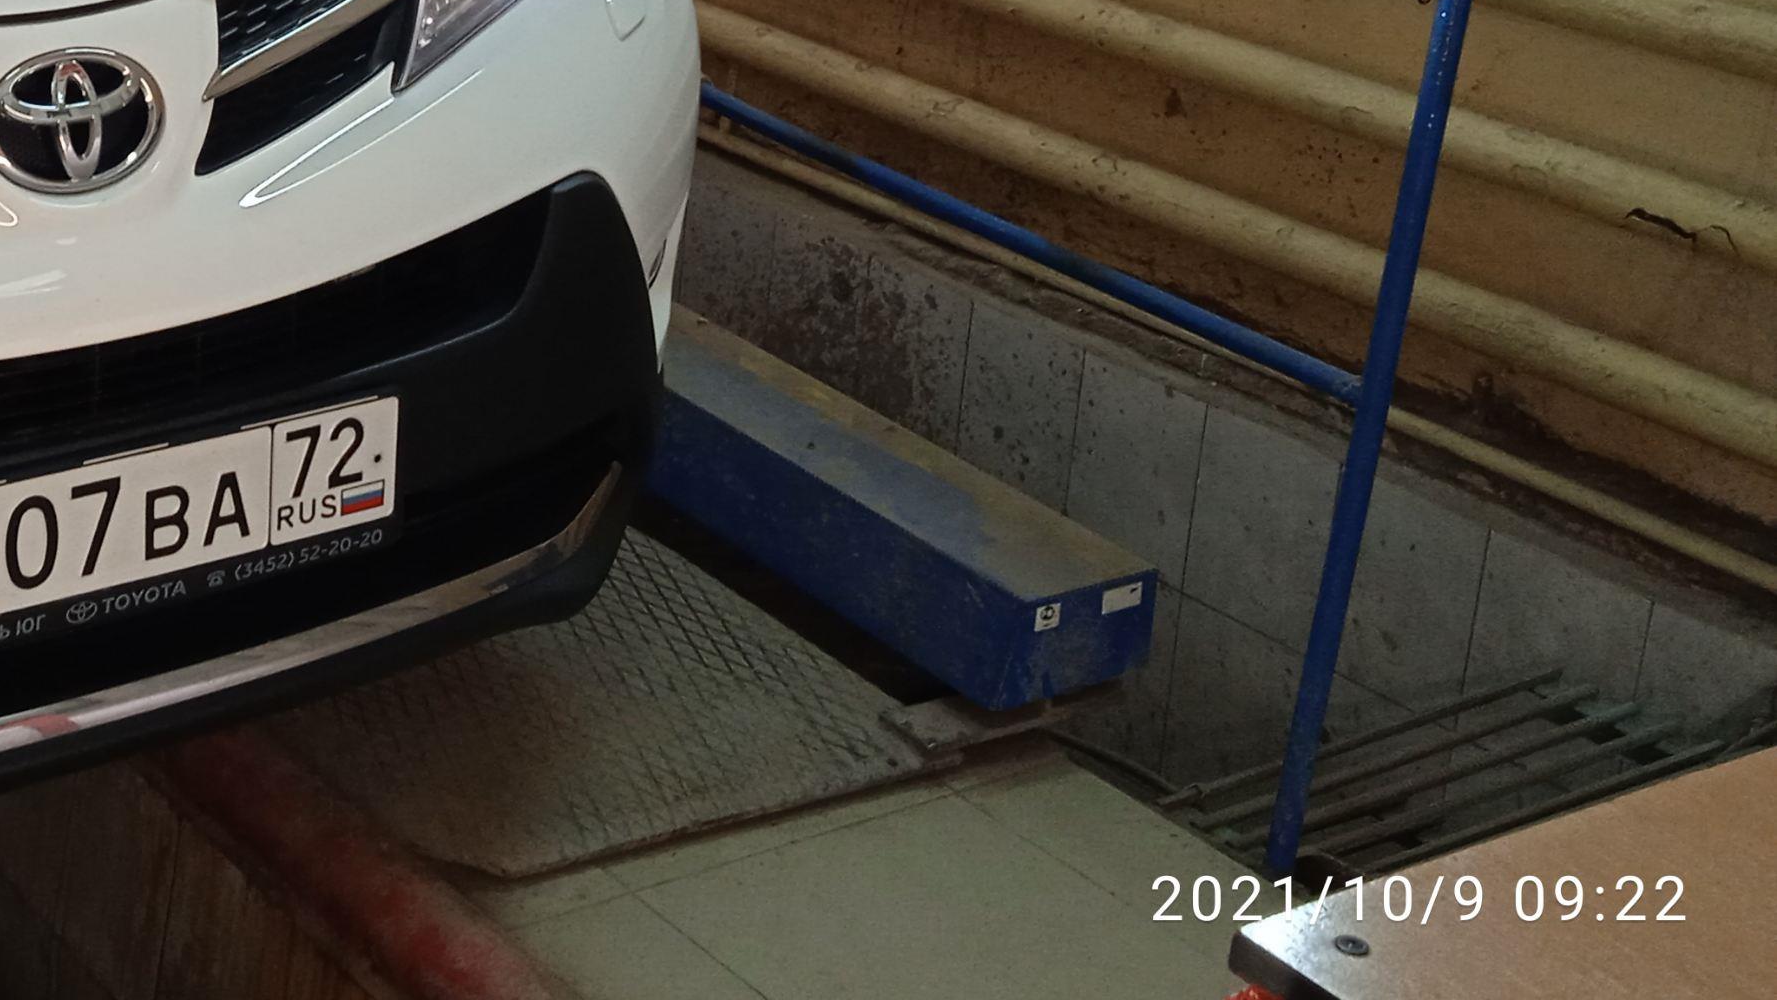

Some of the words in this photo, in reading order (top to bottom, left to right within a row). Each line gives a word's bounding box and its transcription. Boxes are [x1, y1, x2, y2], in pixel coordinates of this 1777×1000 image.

[285, 417, 365, 499] 72
[276, 494, 337, 531] RUS
[102, 581, 187, 614] TOYOTA
[234, 551, 295, 581] (3452)
[299, 529, 383, 563] 52-20-20
[16, 614, 46, 637] ЮГ
